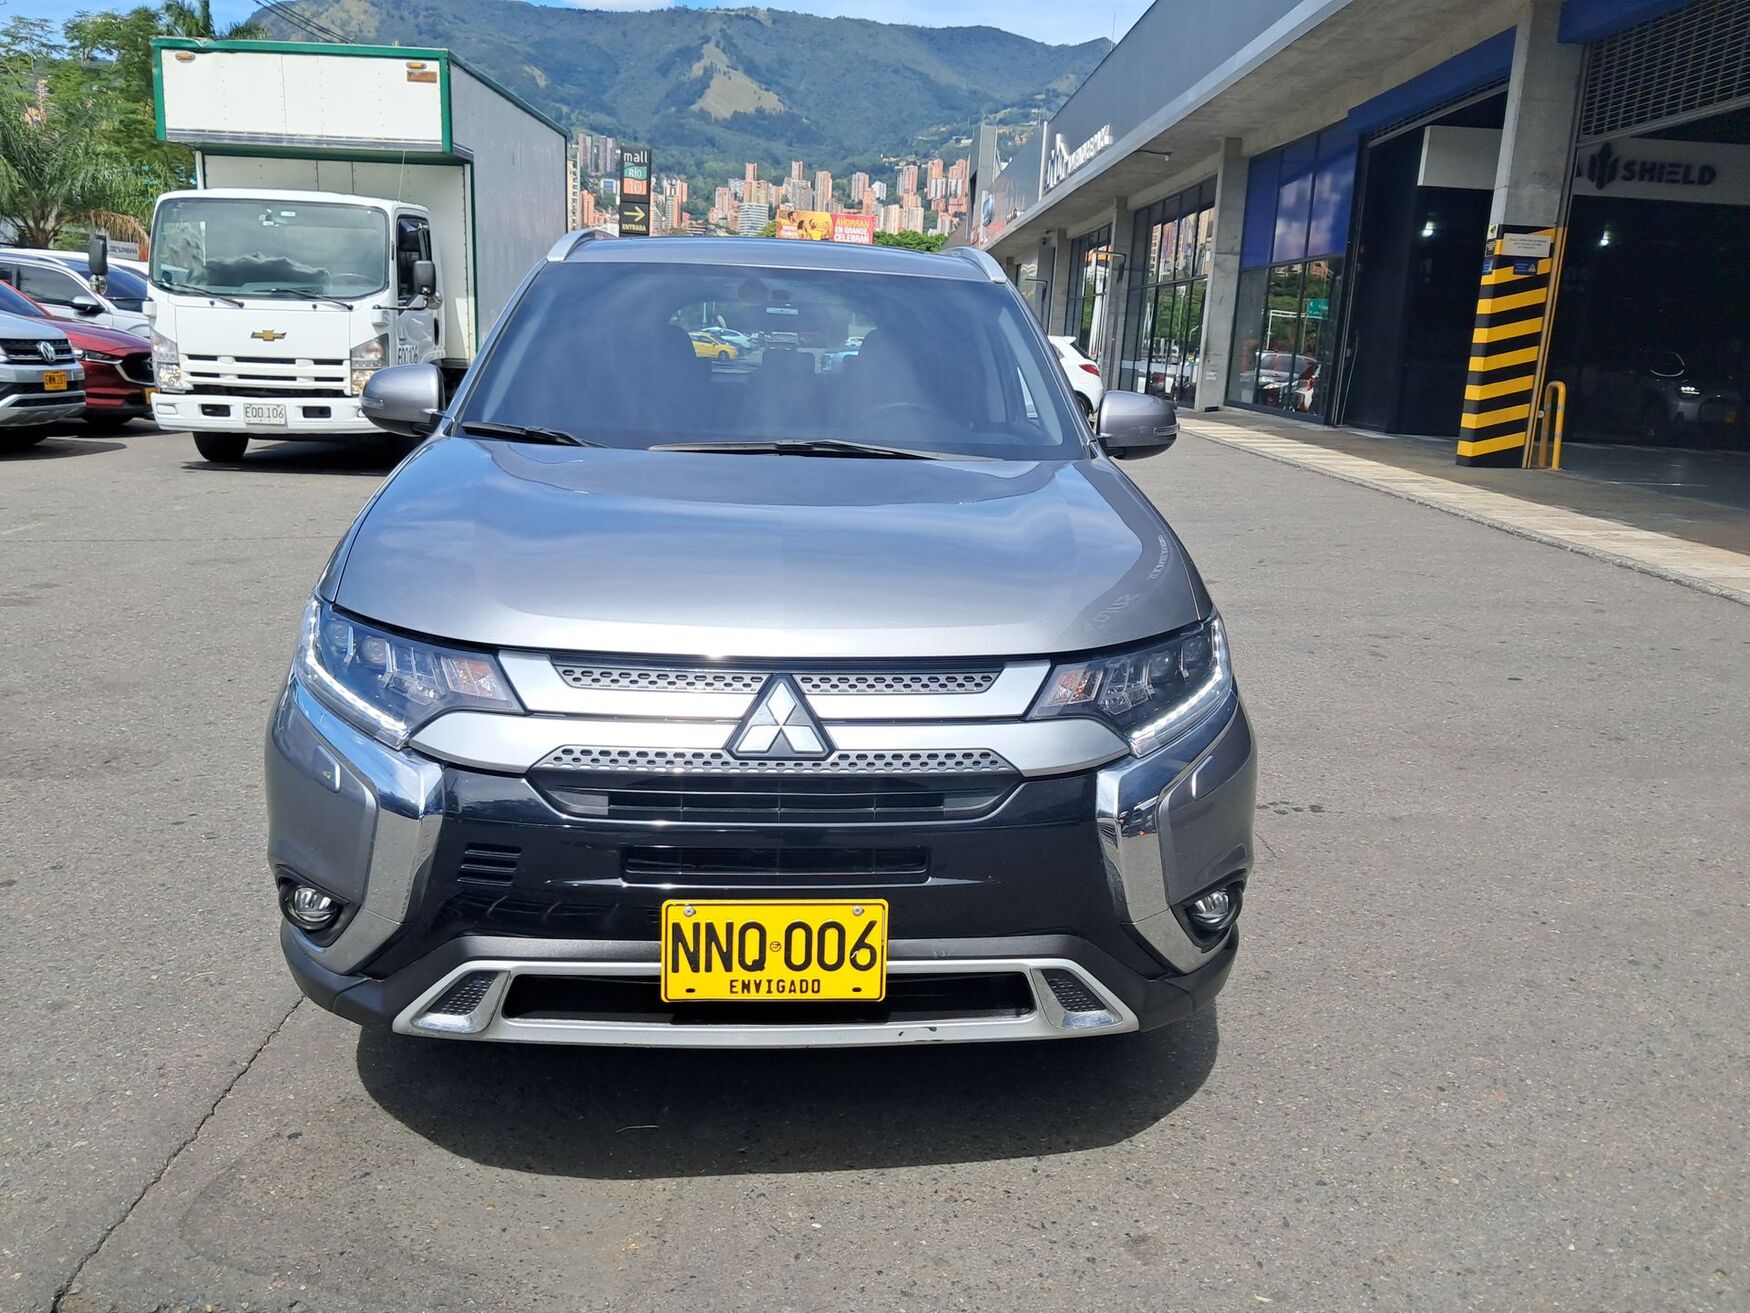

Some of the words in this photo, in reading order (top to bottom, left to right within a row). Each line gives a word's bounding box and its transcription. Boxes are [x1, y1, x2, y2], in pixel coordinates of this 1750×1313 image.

[623, 150, 648, 163] mall
[1620, 159, 1717, 186] SHIELD
[621, 223, 647, 232] ENTRADA
[671, 921, 767, 974] NNQ
[784, 920, 877, 972] 006
[729, 978, 821, 994] ENVIGADO
